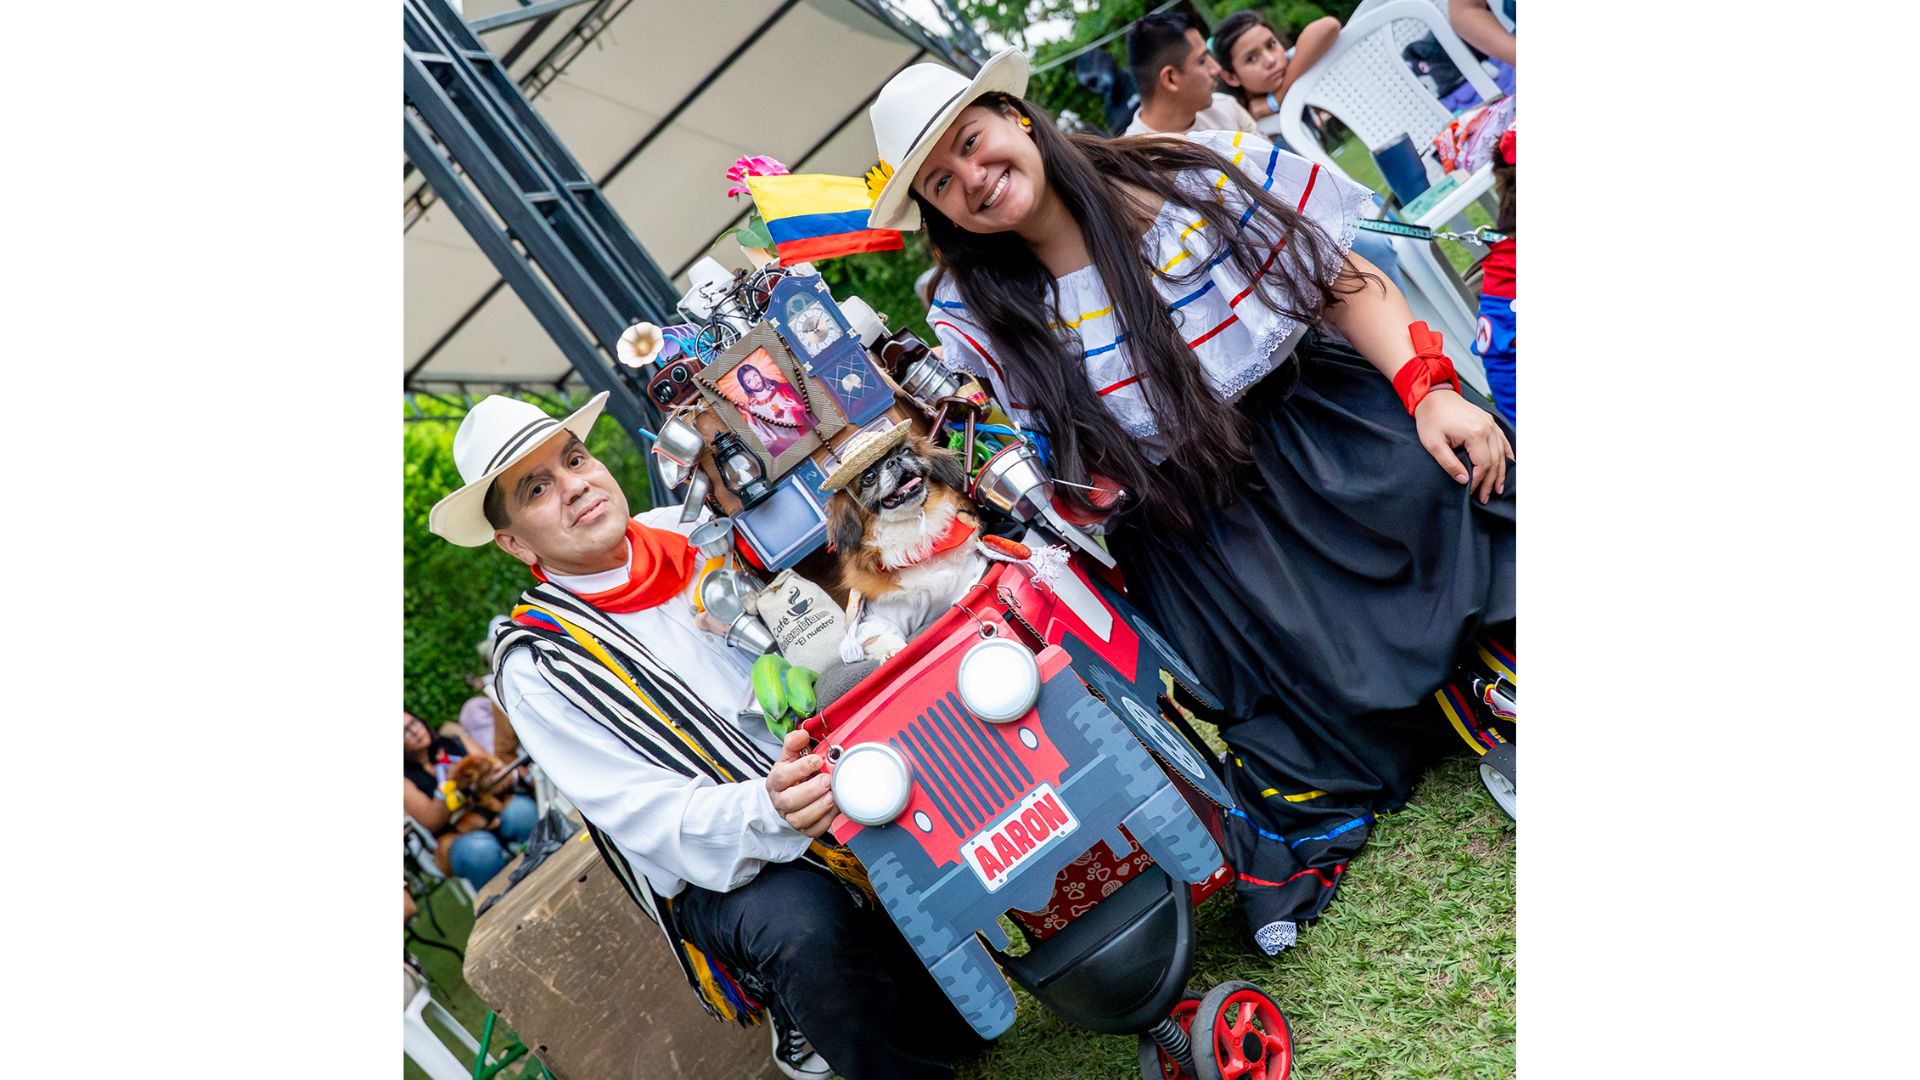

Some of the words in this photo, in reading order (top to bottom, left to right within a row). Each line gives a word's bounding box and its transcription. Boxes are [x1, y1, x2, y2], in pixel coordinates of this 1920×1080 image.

[773, 615, 790, 638] Café
[807, 616, 834, 639] nuestro"
[974, 793, 1069, 881] AARON
